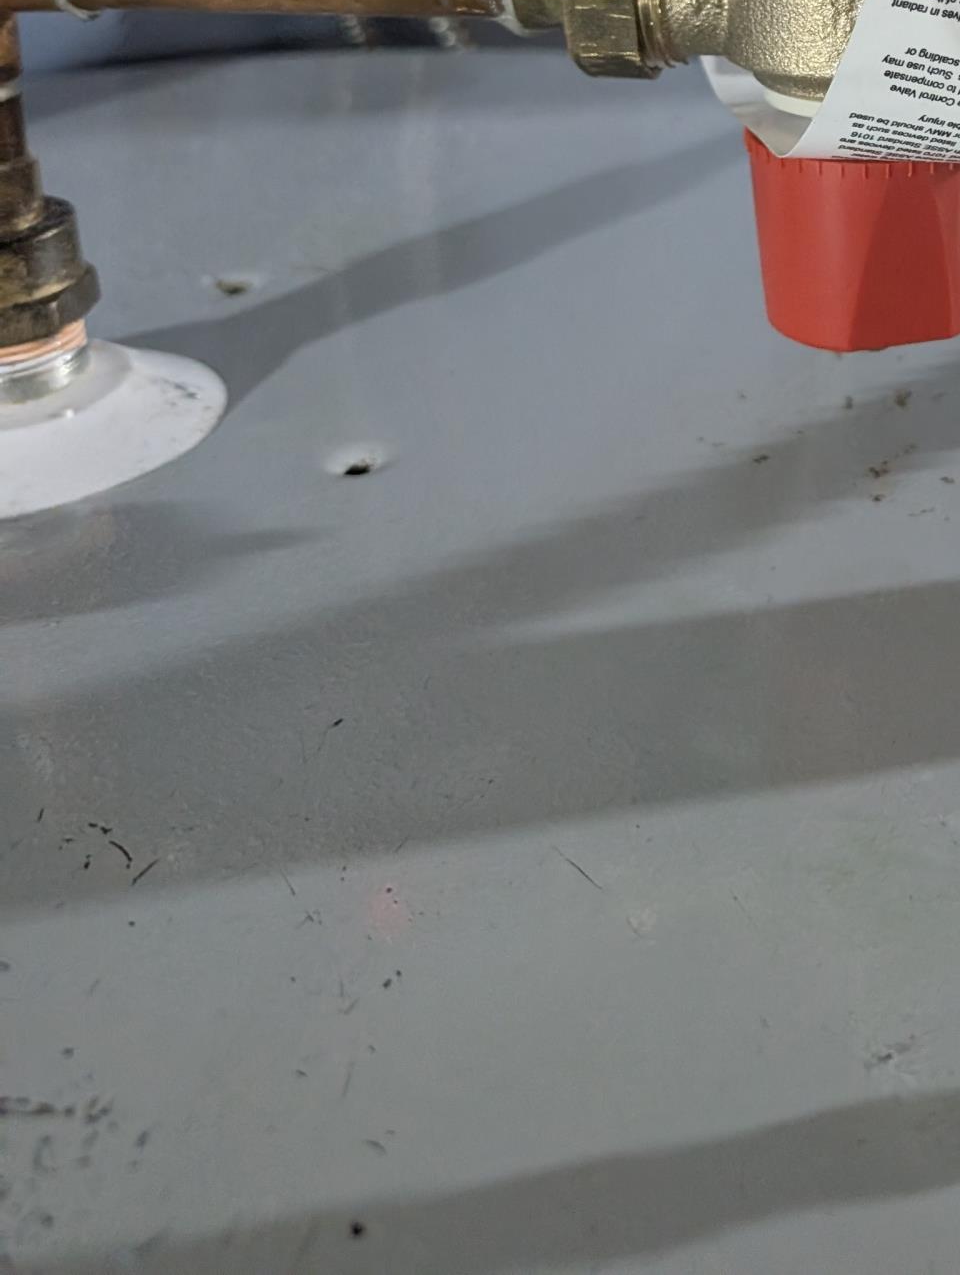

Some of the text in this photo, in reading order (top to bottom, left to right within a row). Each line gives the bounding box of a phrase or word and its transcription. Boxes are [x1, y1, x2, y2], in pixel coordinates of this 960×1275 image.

[892, 0, 929, 13] radiant
[930, 8, 941, 16] in
[905, 48, 918, 56] or
[882, 55, 905, 67] may
[919, 49, 960, 67] scalding
[907, 62, 926, 71] use
[927, 66, 954, 80] Such
[884, 71, 945, 90] compensate
[947, 85, 957, 94] to
[919, 92, 956, 107] Control
[849, 113, 874, 121] used
[866, 125, 890, 134] such
[890, 121, 924, 131] should
[850, 132, 874, 141] 1016
[892, 130, 928, 141] devices
[925, 128, 952, 137] MMV
[877, 136, 921, 148] Standard
[930, 137, 957, 147] listed
[923, 145, 953, 153] ASSE
